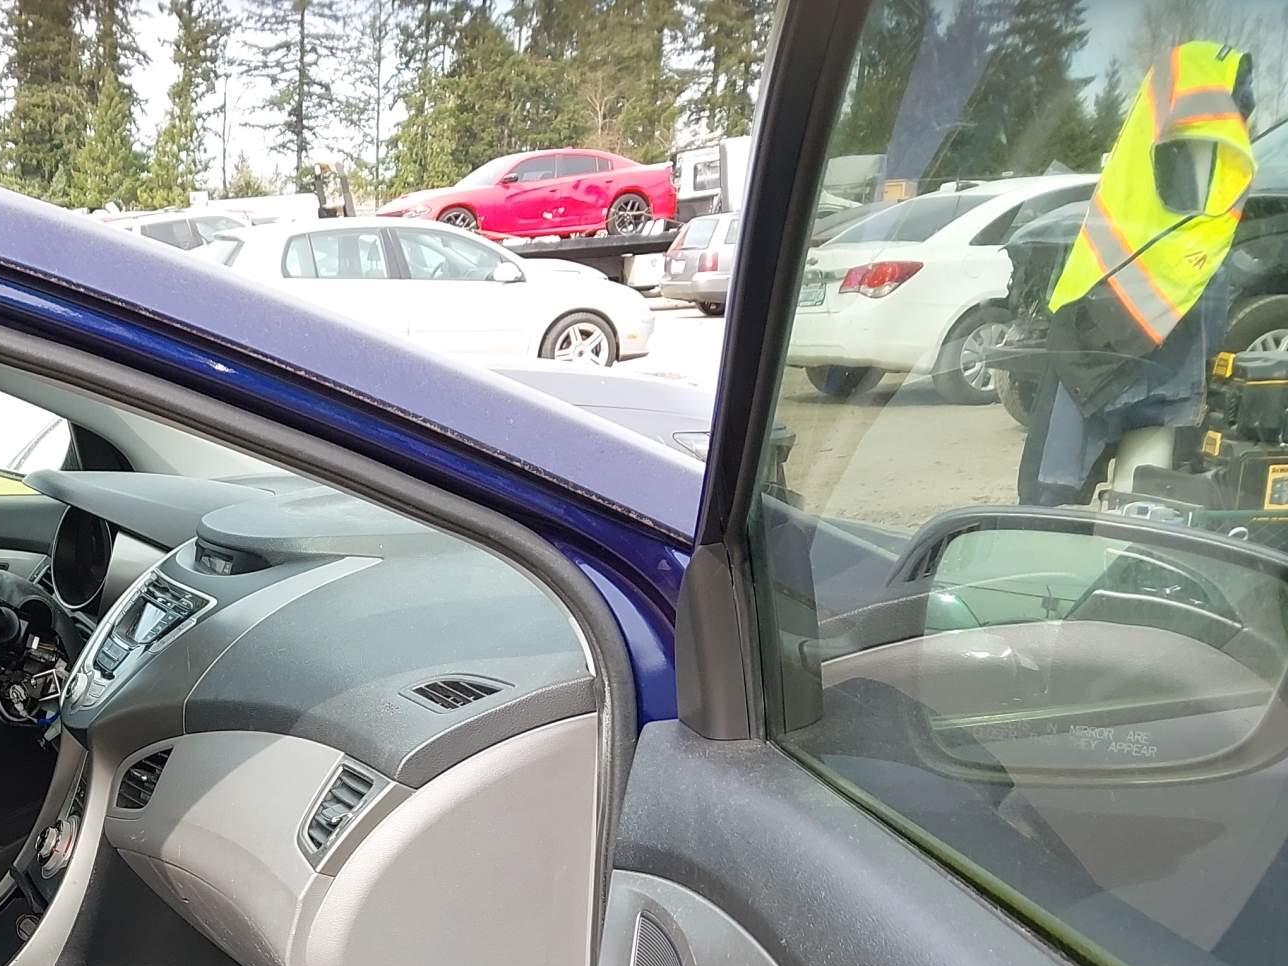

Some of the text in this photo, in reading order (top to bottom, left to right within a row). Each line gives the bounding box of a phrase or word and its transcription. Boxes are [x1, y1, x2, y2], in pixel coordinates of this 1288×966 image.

[1069, 723, 1116, 740] MIRROR
[1127, 730, 1153, 744] ARE
[1106, 741, 1158, 759] APPEAR
